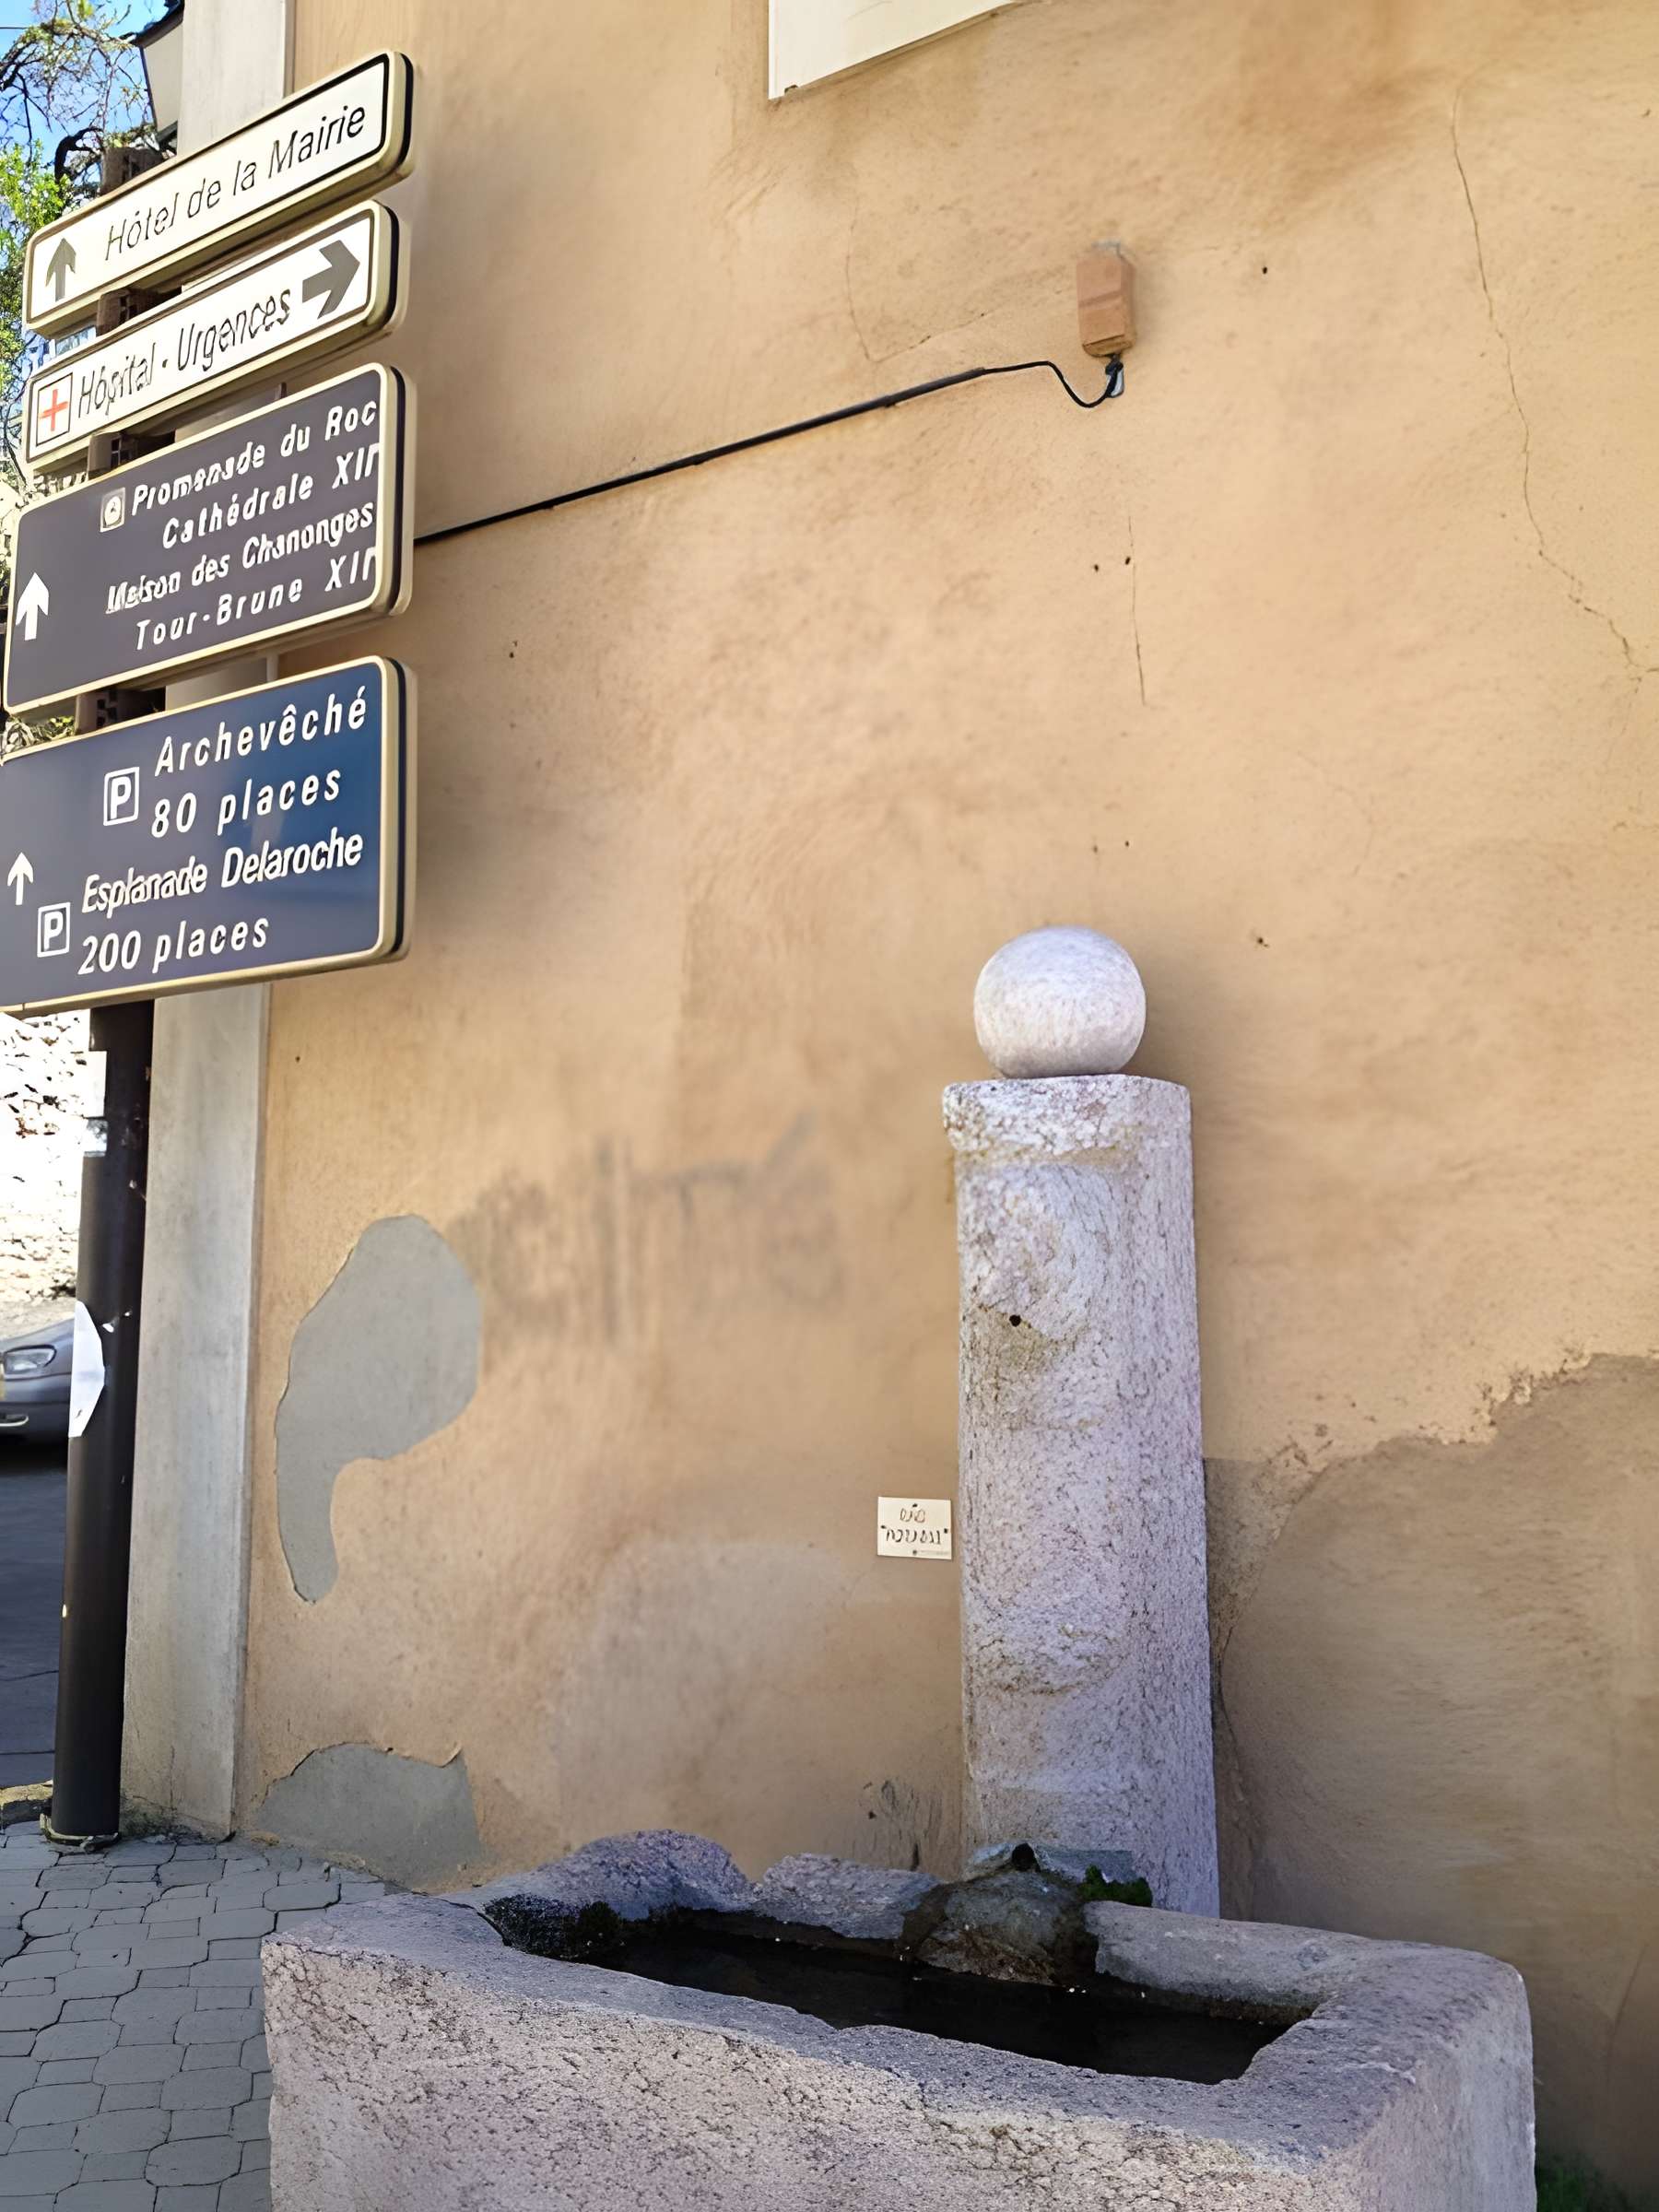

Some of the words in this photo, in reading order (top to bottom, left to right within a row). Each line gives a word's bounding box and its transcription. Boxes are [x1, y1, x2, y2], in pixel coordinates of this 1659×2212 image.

[104, 192, 179, 261] Hôtel
[187, 178, 220, 219] de
[232, 159, 258, 196] la
[268, 105, 366, 180] Mairie
[77, 342, 156, 418] Hôpital
[177, 288, 290, 372] Urgences
[132, 441, 265, 516] Promenade
[281, 424, 311, 457] du
[324, 401, 377, 441] Roc
[162, 474, 313, 549] Cathédrale
[105, 574, 181, 615] Maison
[192, 554, 230, 587] des
[155, 686, 366, 777] Archevêché
[151, 793, 197, 838] 80
[217, 769, 341, 836] places
[81, 855, 207, 919] Esplanade
[221, 827, 363, 888] Delaroche
[77, 930, 142, 975] 200
[152, 918, 269, 973] places
